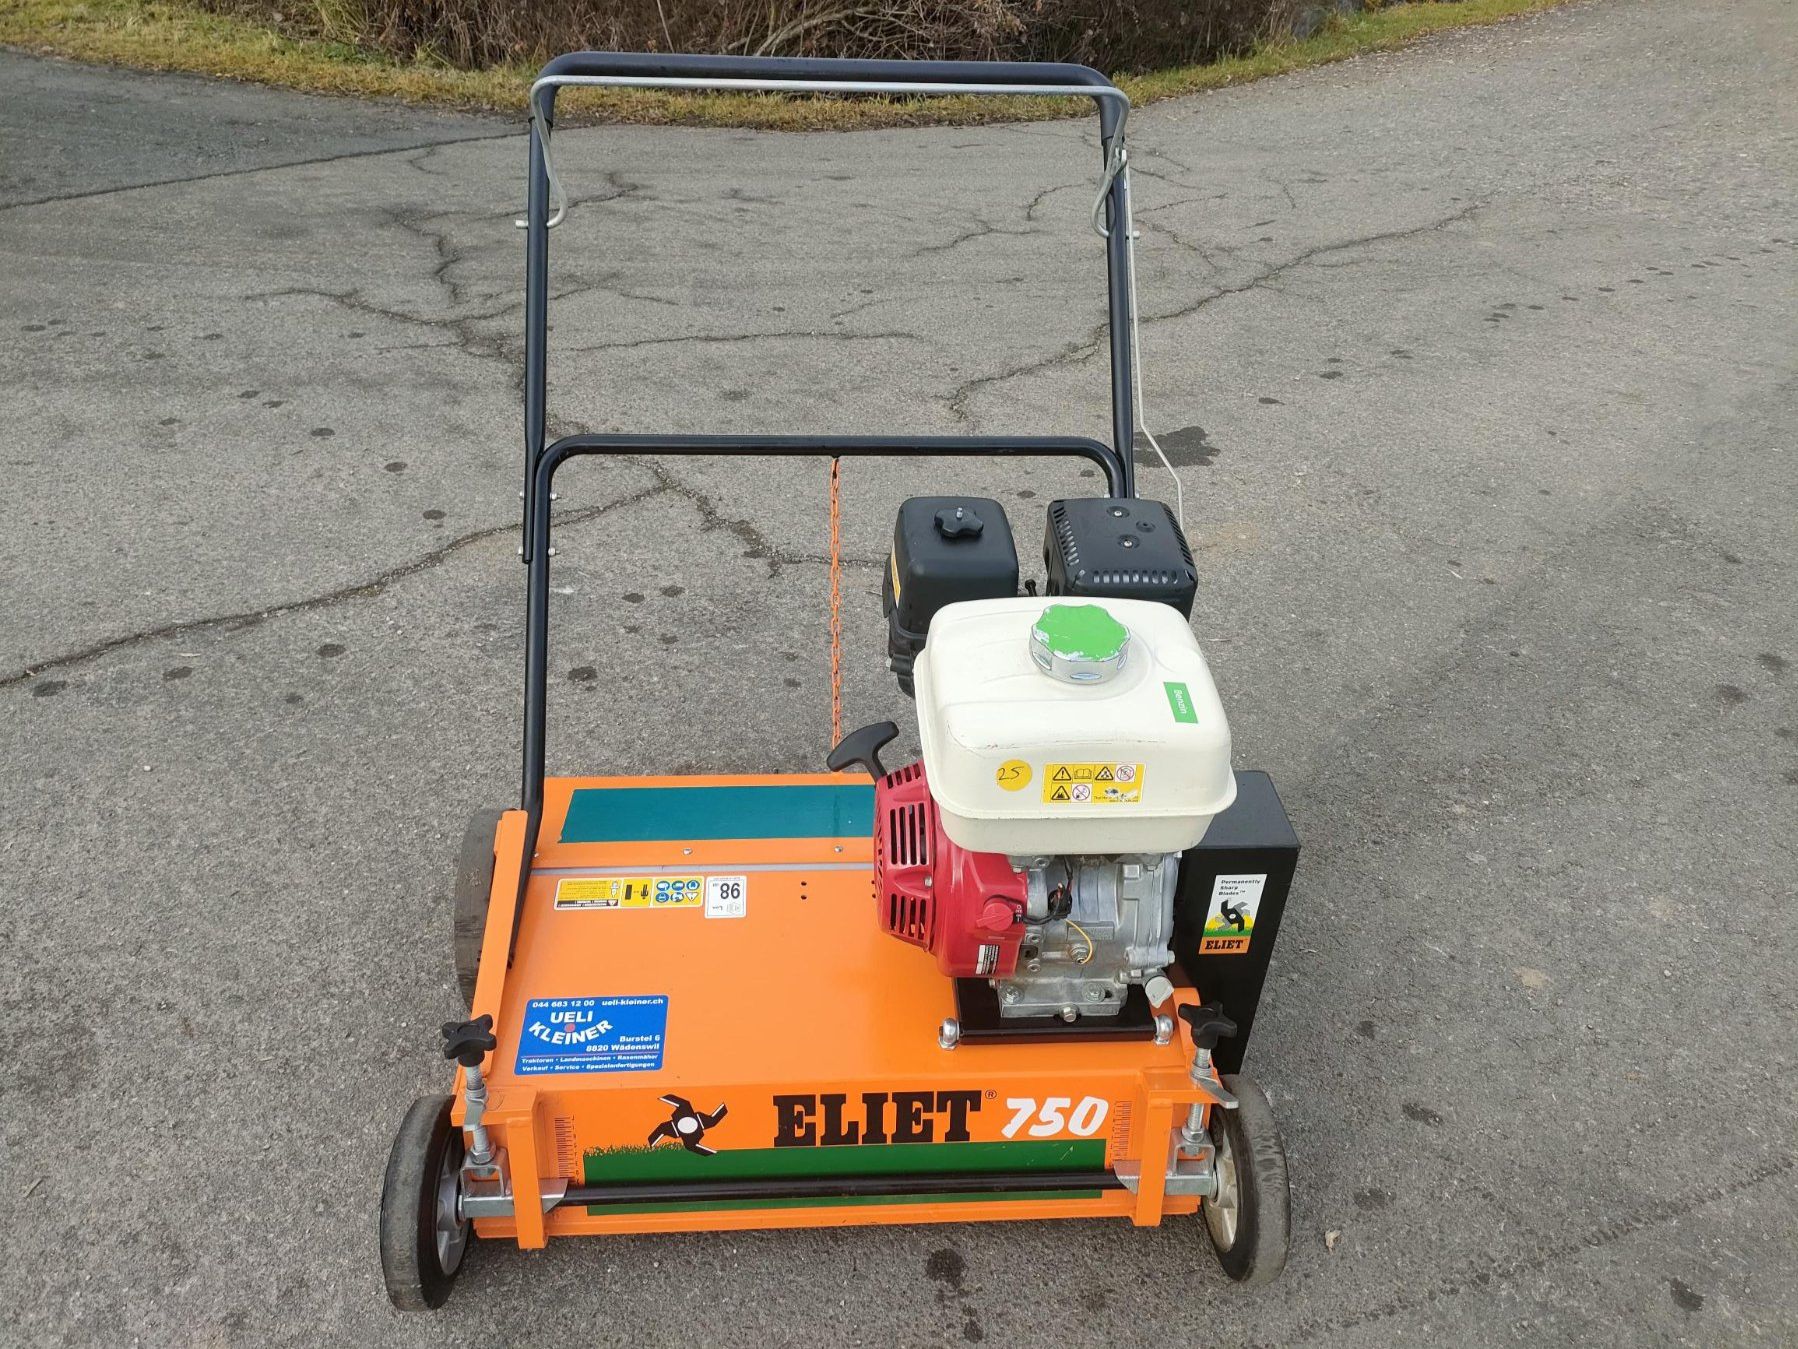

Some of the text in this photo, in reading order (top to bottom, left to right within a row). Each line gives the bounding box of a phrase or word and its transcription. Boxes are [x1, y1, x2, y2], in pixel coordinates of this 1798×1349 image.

[997, 766, 1025, 781] 25
[1204, 940, 1243, 950] ELIET
[532, 1000, 549, 1008] 044
[551, 1000, 568, 1008] 683
[583, 999, 595, 1007] 00
[601, 998, 664, 1006] ueli-kleiner.ch
[550, 1011, 593, 1023] UELI
[528, 1019, 613, 1045] KLEINER
[586, 1043, 660, 1052] 8820 Wädenswil
[1001, 1096, 1109, 1138] 750
